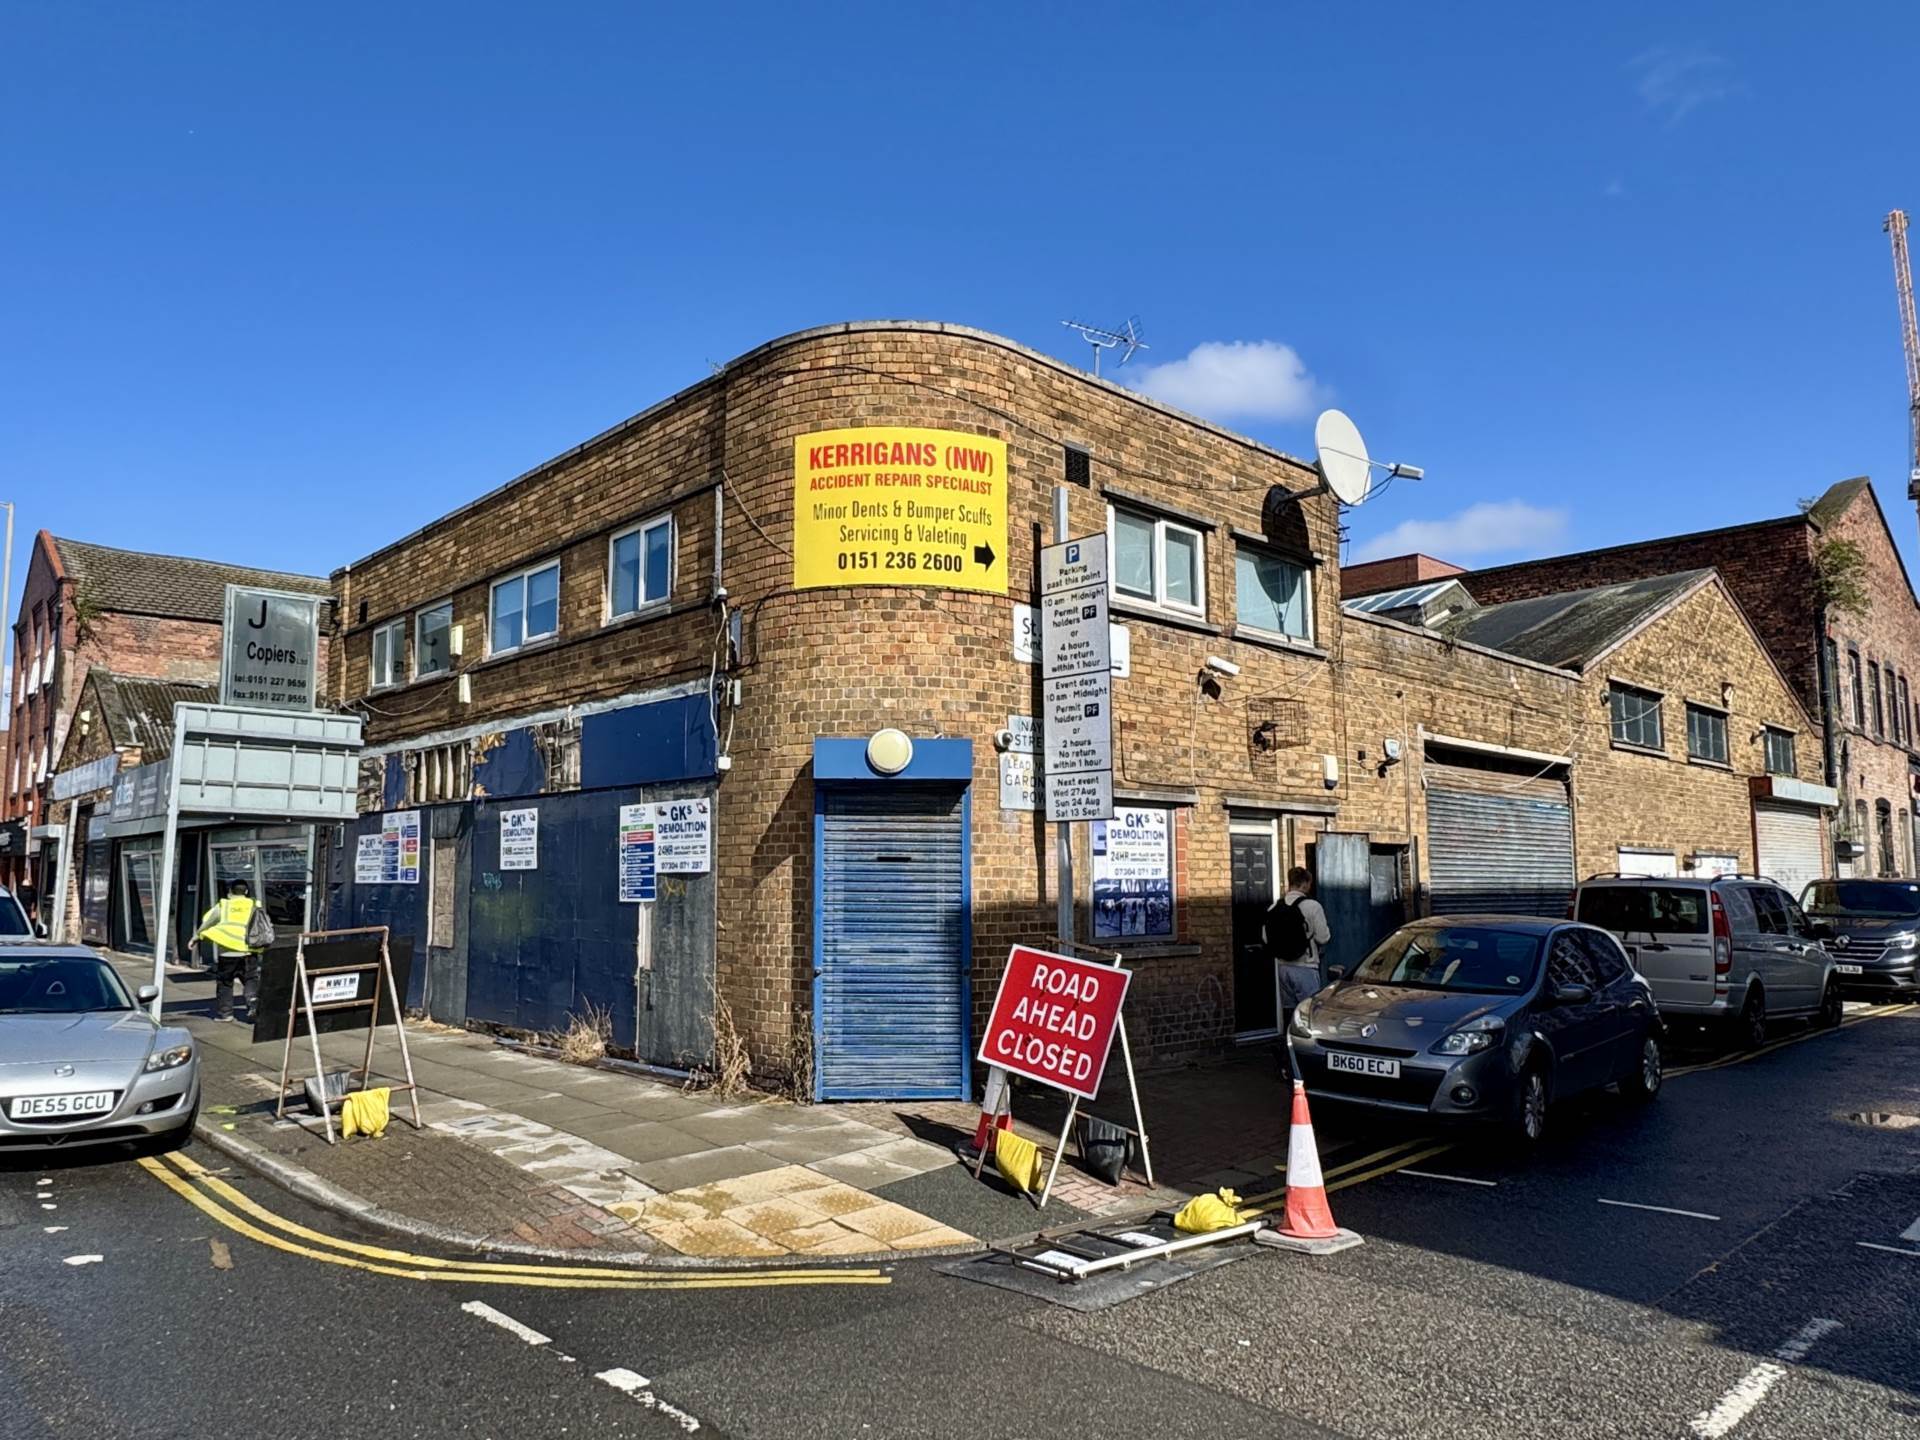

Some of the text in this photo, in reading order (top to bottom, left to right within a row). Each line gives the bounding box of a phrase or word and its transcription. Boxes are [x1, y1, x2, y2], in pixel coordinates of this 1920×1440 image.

[810, 442, 994, 477] KERRIGANS (NW)
[810, 473, 993, 496] ACCIDENT REPAIR SPECIALIST
[813, 500, 992, 526] Minor Dents & Bumper Scuffs
[839, 523, 967, 550] Servicing & Valeting
[838, 552, 963, 573] 0151 236 2600
[1059, 565, 1087, 576] Parking
[1046, 570, 1101, 590] past this point
[1044, 598, 1053, 607] 10
[1054, 597, 1065, 606] am
[1071, 588, 1104, 602] Midnight
[248, 600, 267, 629] J
[1054, 606, 1096, 619] Permit PF
[1052, 617, 1080, 628] holders
[1070, 630, 1079, 638] or
[1060, 641, 1090, 651] 4 hours
[247, 641, 296, 666] Copiers
[1057, 650, 1094, 662] No return
[1051, 662, 1075, 673] within
[1082, 659, 1101, 669] hour
[270, 677, 285, 686] 227
[1055, 678, 1097, 690] Event days
[271, 692, 286, 702] 227
[1046, 693, 1055, 702] 10
[1056, 693, 1068, 701] am
[1073, 687, 1107, 699] Midnight
[1056, 703, 1098, 716] Permit PF
[1054, 715, 1083, 723] holders
[1021, 720, 1043, 734] NAY
[1014, 735, 1043, 749] STRE
[1062, 739, 1092, 748] 2 hours
[1059, 749, 1096, 758] No return
[1053, 760, 1077, 769] within
[1084, 759, 1102, 767] hour
[1005, 773, 1045, 788] GARDN
[1057, 776, 1099, 787] Next event
[1053, 787, 1097, 797] Wed 27 Aug
[1055, 797, 1100, 808] Sun 24 Aug
[1056, 807, 1100, 818] Sat 13 Sept
[658, 821, 707, 834] DEMOLITION
[1110, 829, 1164, 840] DEMOLITION
[1031, 963, 1099, 1003] ROAD
[1012, 996, 1096, 1041] AHEAD
[997, 1029, 1092, 1081] CLOSED
[1332, 1055, 1395, 1075] BK60 ECJ
[72, 1095, 106, 1111] GCU
